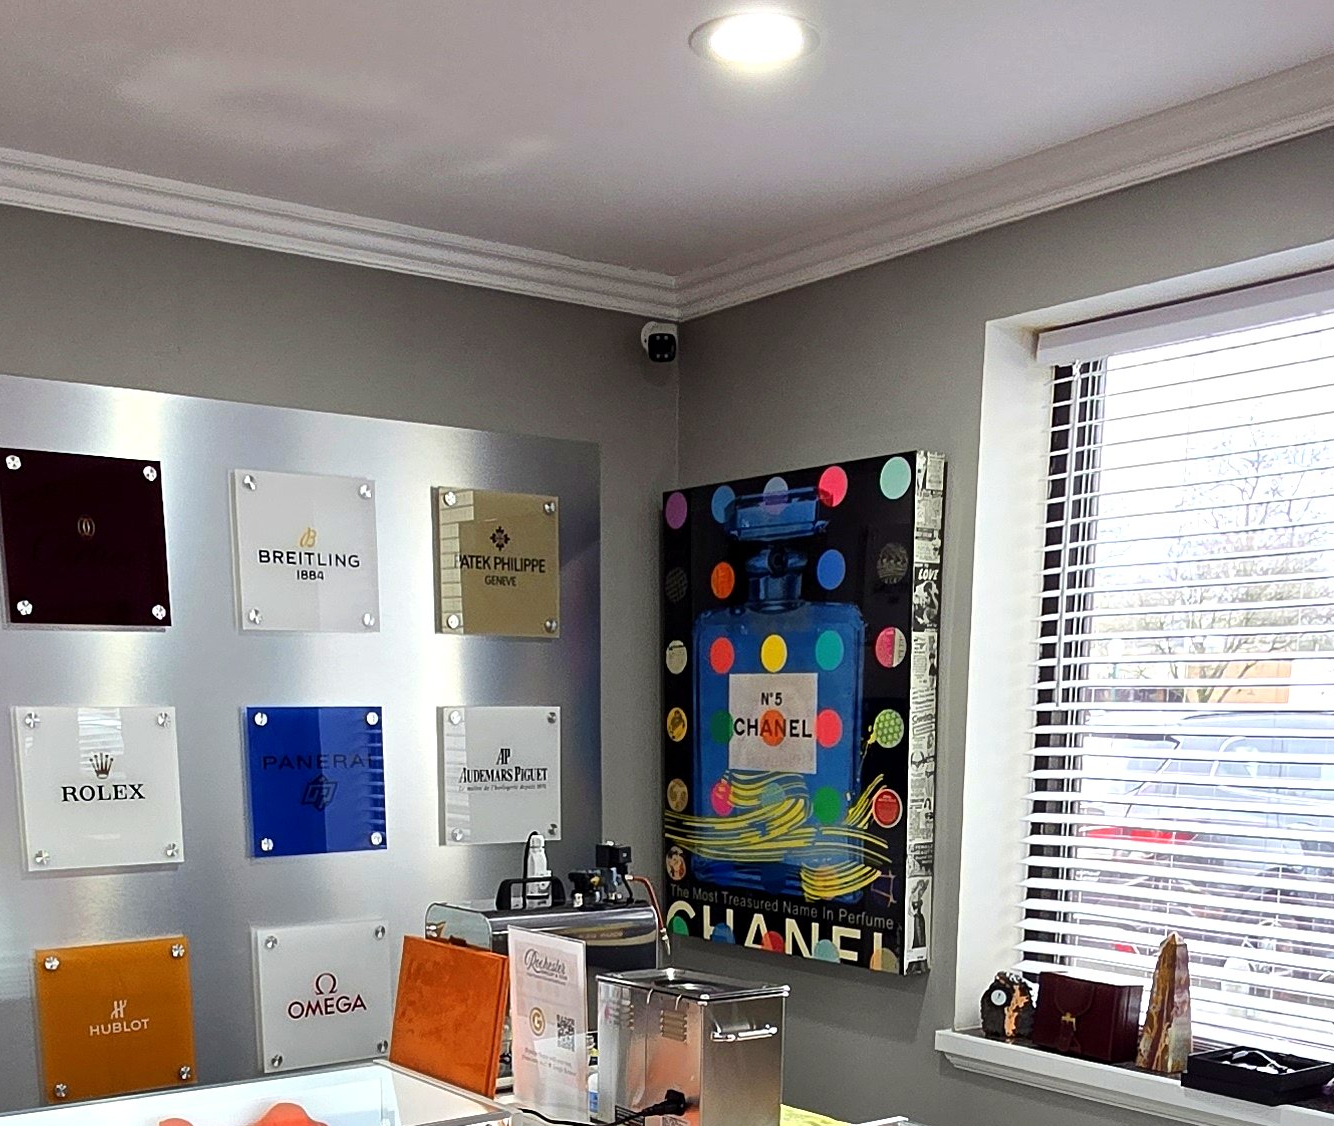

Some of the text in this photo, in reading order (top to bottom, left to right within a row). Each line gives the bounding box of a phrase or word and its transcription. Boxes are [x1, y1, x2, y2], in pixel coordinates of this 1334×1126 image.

[258, 549, 361, 568] BREITLING
[454, 554, 546, 573] PATEK PHILIPPE
[296, 570, 325, 581] 1884
[484, 575, 517, 587] GENEVE
[917, 568, 939, 581] LOVE
[733, 717, 813, 738] CHANEL
[262, 753, 373, 770] PANERAI
[458, 766, 548, 783] AUDEMARS PIGUET
[61, 783, 146, 802] ROLEX
[670, 883, 894, 931] The Most Treasured Name In Perfume
[288, 994, 367, 1020] OMEGA
[89, 1018, 150, 1037] HUBLOT
